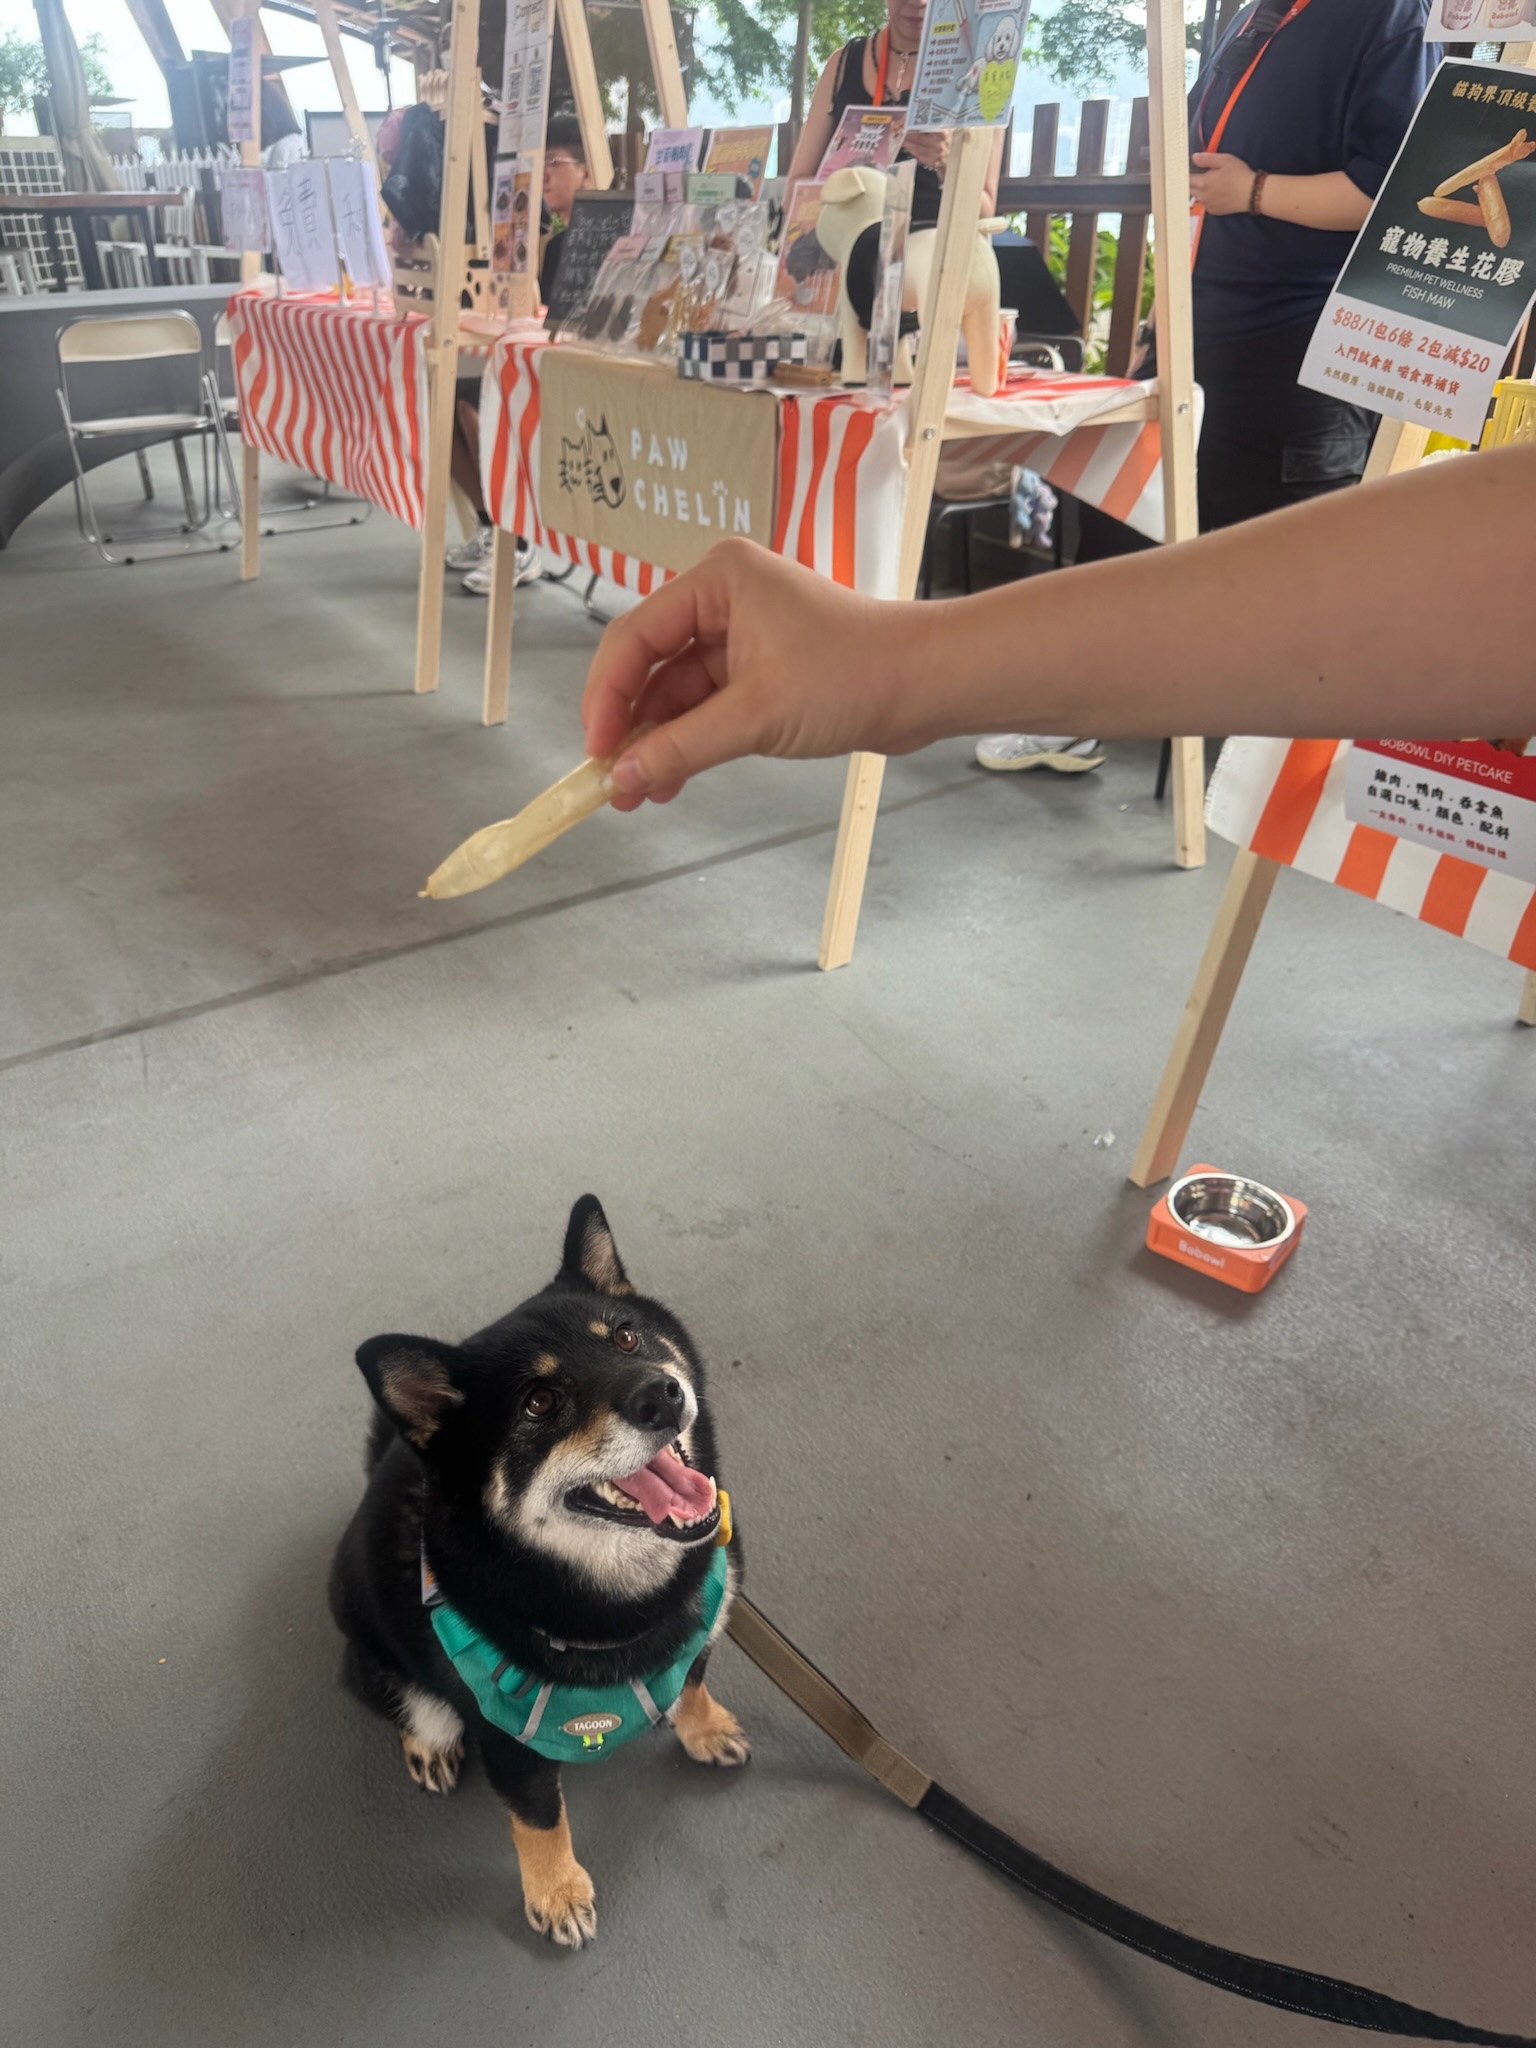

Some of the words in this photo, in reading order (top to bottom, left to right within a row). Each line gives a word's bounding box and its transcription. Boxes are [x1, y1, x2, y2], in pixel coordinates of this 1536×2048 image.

[1379, 224, 1525, 287] 寵物養生花膠
[1385, 262, 1424, 283] PREMIUM
[1422, 273, 1440, 287] PET
[1440, 278, 1485, 300] WELLNESS
[1402, 284, 1426, 302] FISH
[1426, 291, 1456, 310] MAW
[1332, 306, 1414, 349] $88/1包6條
[1417, 336, 1491, 374] 2包減$20
[1334, 343, 1394, 373] 入門試食裝
[629, 427, 689, 472] PAW
[633, 477, 752, 534] CHELIN
[1433, 750, 1456, 767] DIY
[1456, 757, 1514, 785] PETCAKE
[573, 1718, 613, 1731] TAGOON
